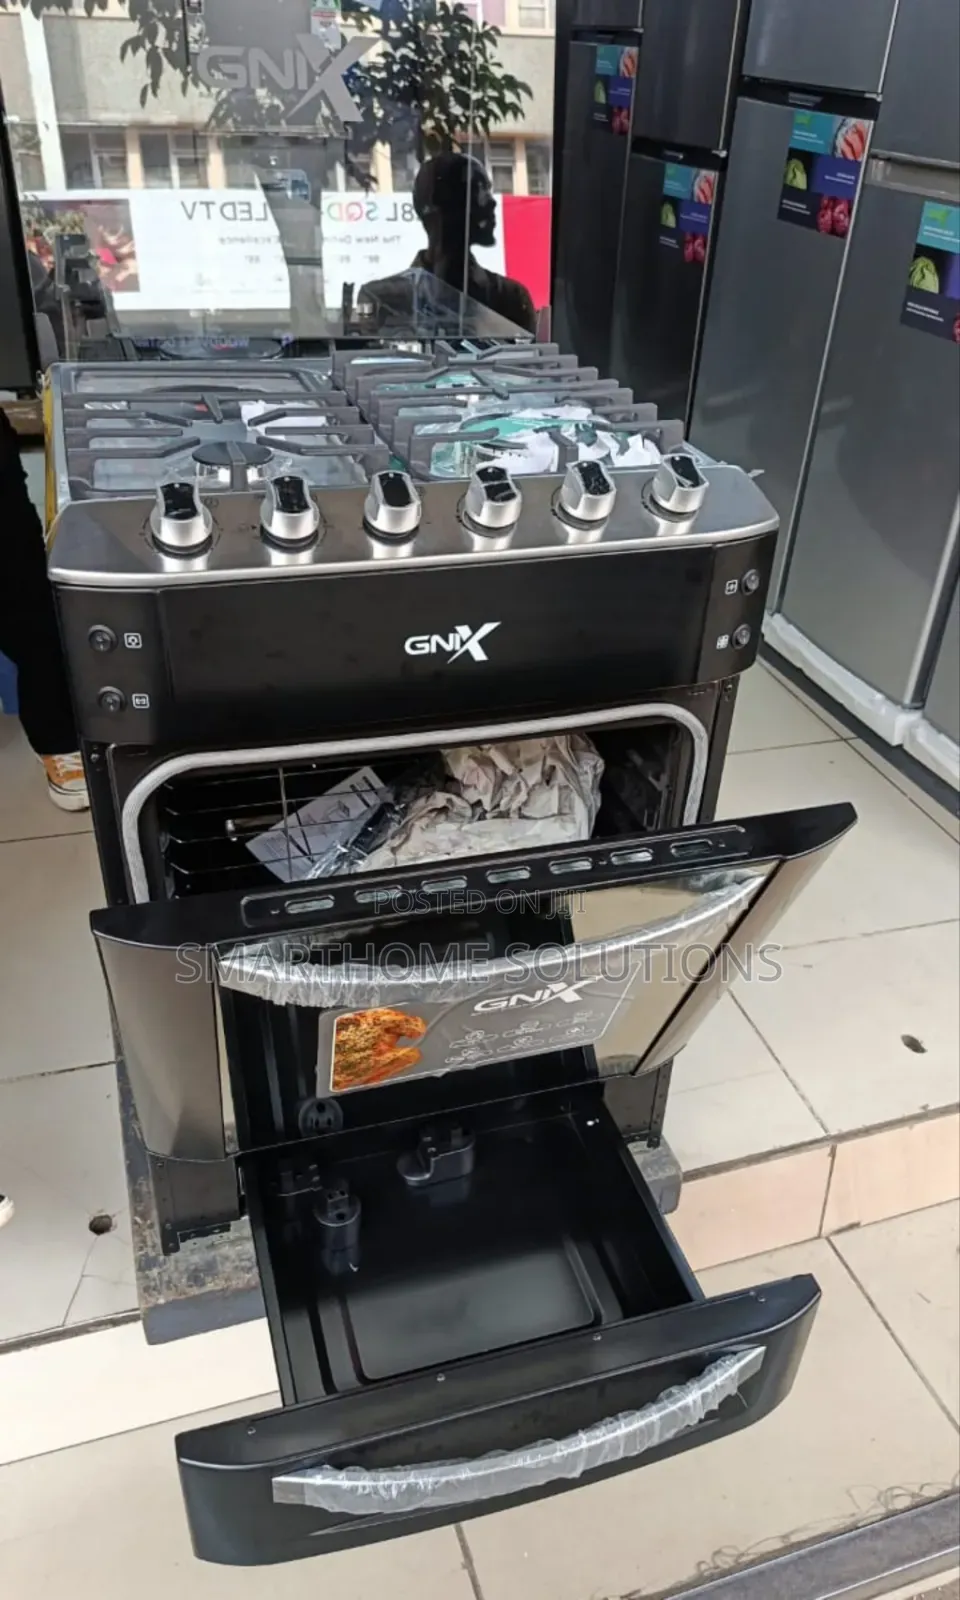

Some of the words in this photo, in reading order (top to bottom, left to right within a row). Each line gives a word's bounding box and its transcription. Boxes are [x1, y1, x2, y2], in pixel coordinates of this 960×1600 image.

[196, 33, 380, 122] GNIX
[404, 621, 502, 664] GNIX
[473, 976, 598, 1012] GNIX
